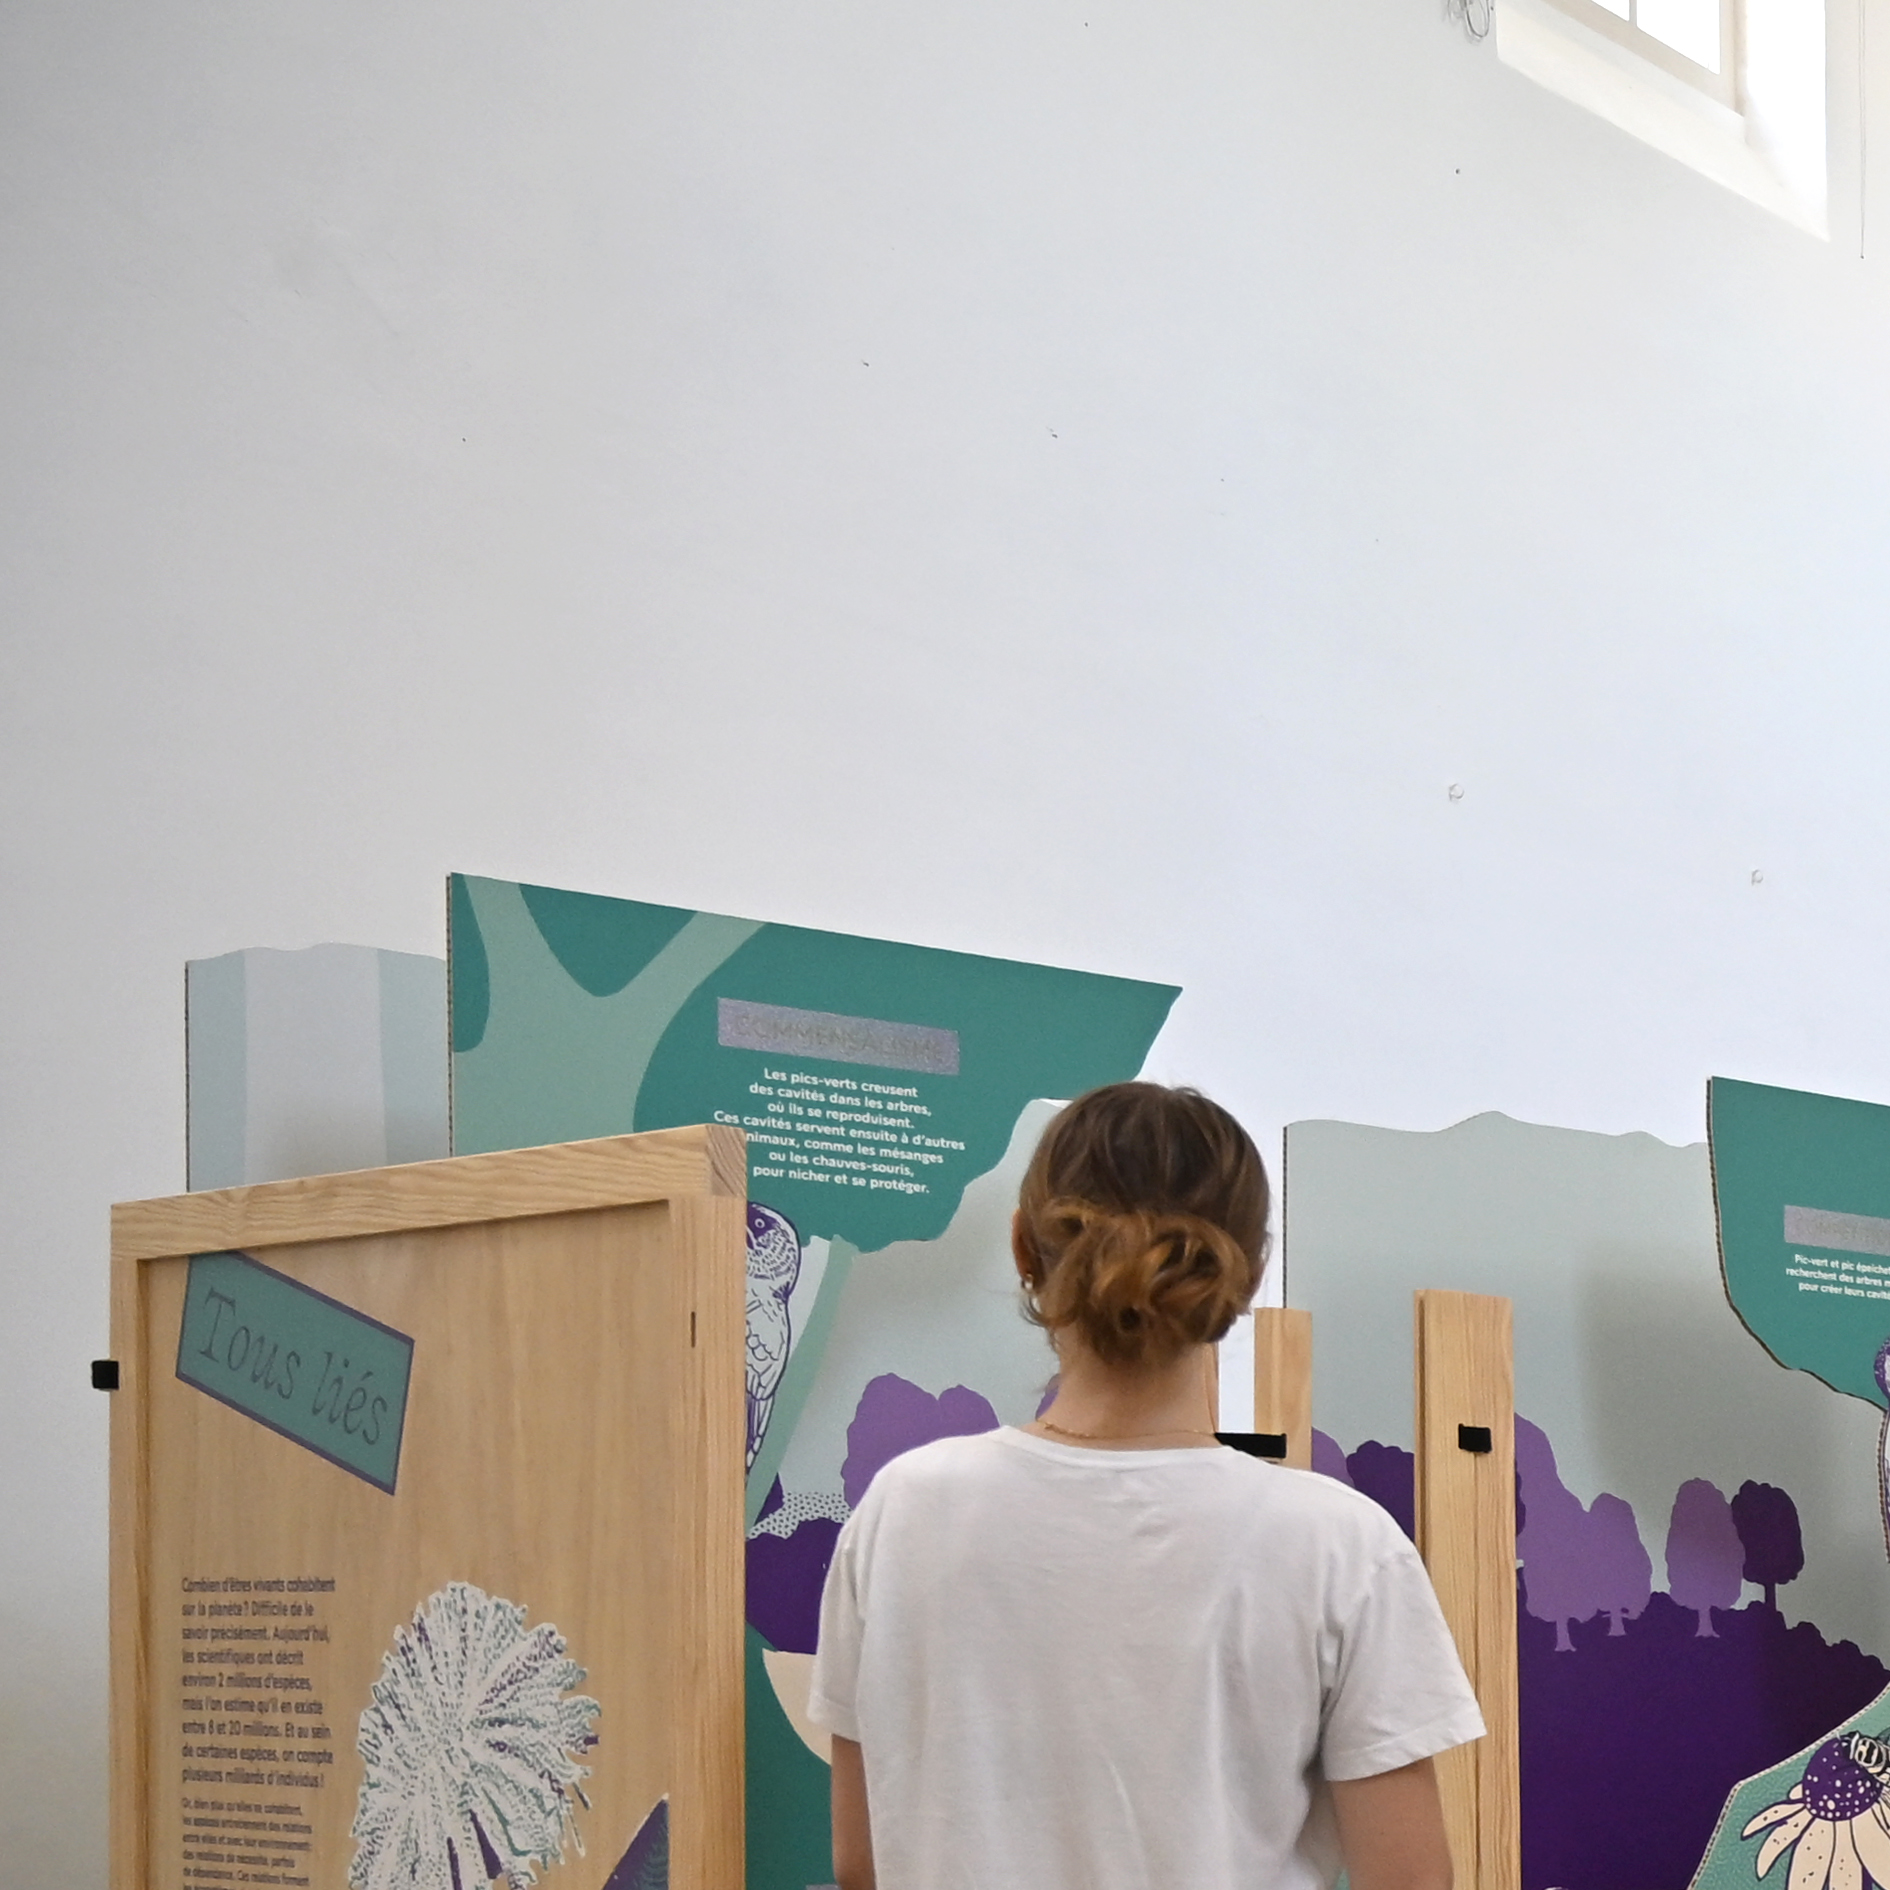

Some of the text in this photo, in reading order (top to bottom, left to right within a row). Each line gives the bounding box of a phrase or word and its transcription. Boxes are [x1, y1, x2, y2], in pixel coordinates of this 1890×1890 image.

[764, 1068, 918, 1097] Les pics-verts creusent
[749, 1082, 932, 1116] des cavités dans les arbres,
[767, 1101, 914, 1128] où ils se reproduisent.
[713, 1111, 965, 1150] Ces cavités servent ensuite à d'autres
[747, 1131, 944, 1165] nimaux, comme les mésanges
[769, 1151, 914, 1177] ou les chauves-souris,
[753, 1166, 930, 1194] pour nicher et se protéger.
[199, 1287, 388, 1446] Tous liés
